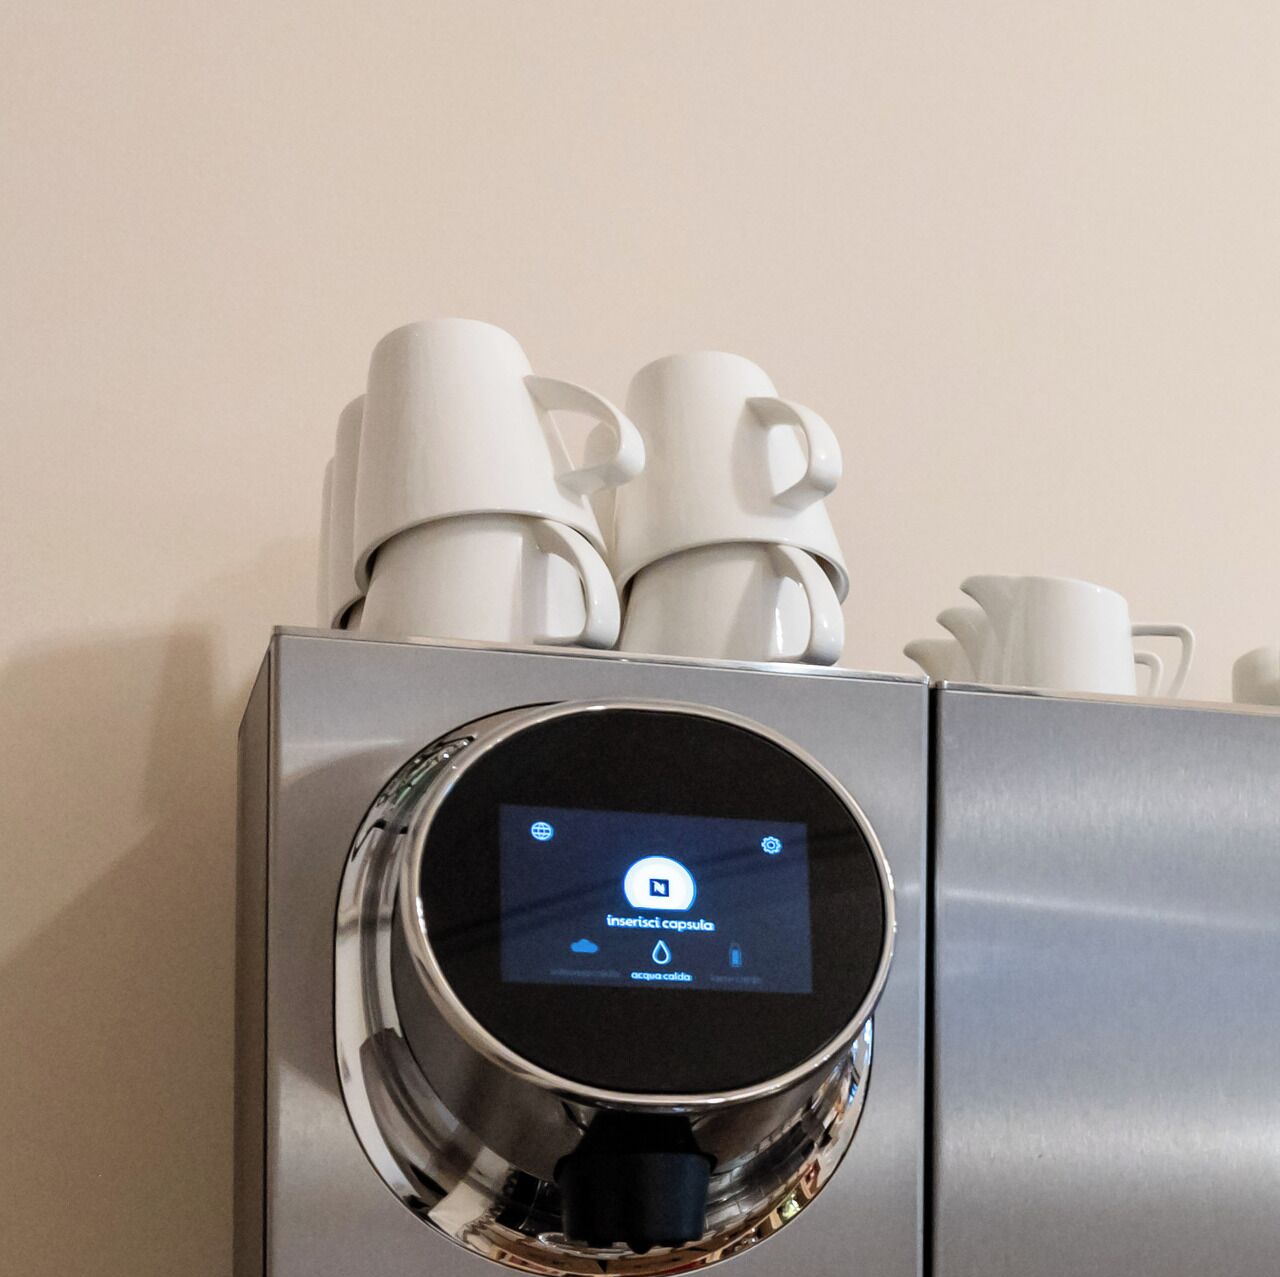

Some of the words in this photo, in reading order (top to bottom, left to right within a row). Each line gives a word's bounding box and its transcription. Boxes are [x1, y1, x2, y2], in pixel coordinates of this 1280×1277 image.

[606, 914, 660, 929] inserisci
[662, 918, 716, 933] capsula
[630, 970, 661, 982] acqua
[662, 971, 693, 982] calda
